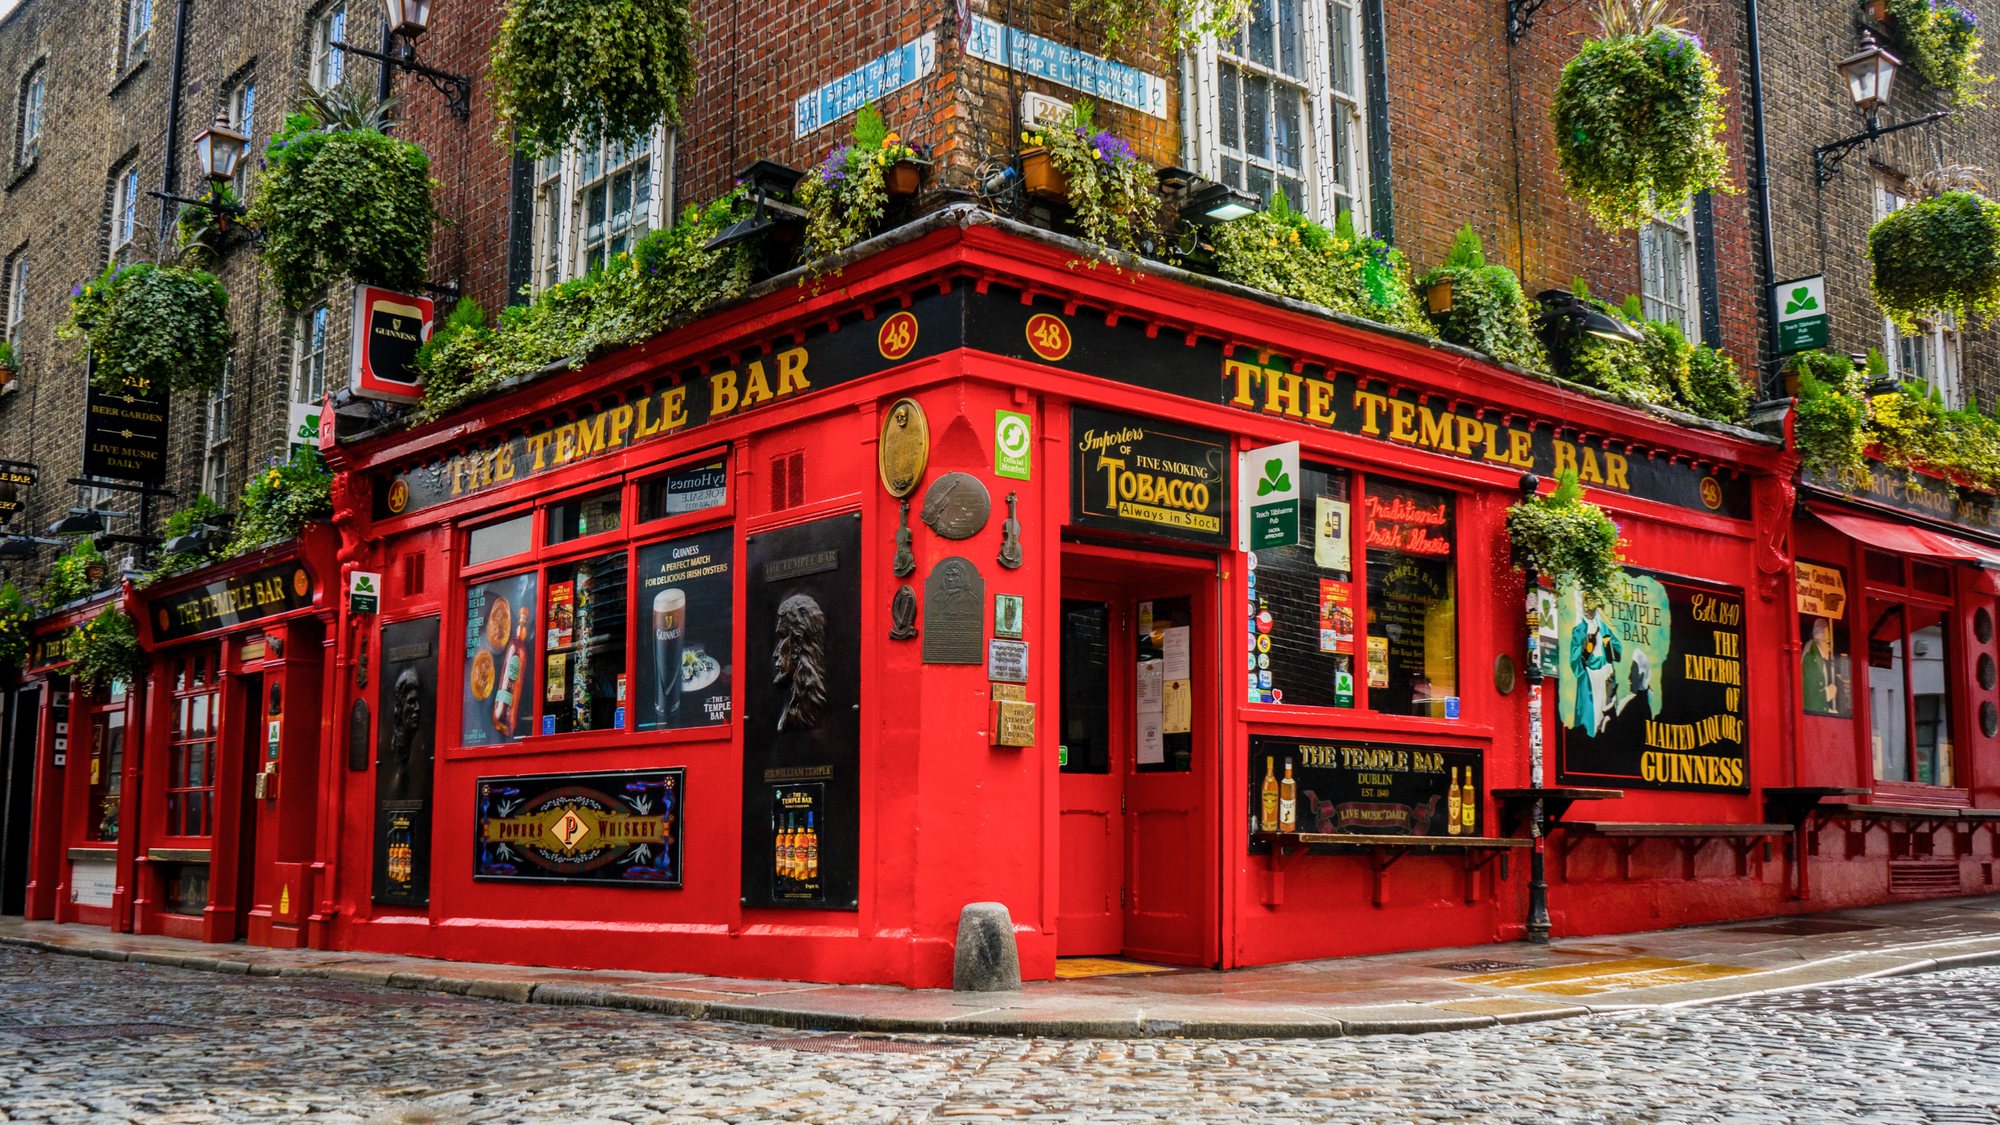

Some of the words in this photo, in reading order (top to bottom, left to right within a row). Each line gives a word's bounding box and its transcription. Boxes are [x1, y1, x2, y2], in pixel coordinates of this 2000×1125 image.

[1041, 44, 1056, 60] AN
[1062, 67, 1094, 90] LANE
[1098, 79, 1138, 105] SOUTH
[835, 84, 874, 114] TEMPLE
[375, 327, 417, 342] GUINNESS
[884, 320, 911, 352] 48
[1034, 319, 1062, 350] 48
[92, 404, 119, 417] BEER
[120, 409, 163, 423] GARDEN
[450, 442, 516, 495] THE
[528, 385, 690, 473] TEMPLE
[708, 346, 812, 420] BAR
[1222, 358, 1337, 428] THE
[1353, 389, 1536, 472] TEMPLE
[1552, 439, 1631, 493] BAR
[92, 443, 120, 455] LIVE
[121, 447, 159, 460] MUSIC
[1079, 427, 1145, 456] Importers
[1119, 445, 1132, 456] OF
[107, 457, 142, 470] DAILY
[1001, 462, 1026, 474] Member
[1136, 455, 1161, 471] FINE
[1161, 459, 1209, 480] SMOKING
[10, 473, 31, 484] BAR
[1096, 455, 1210, 513] TOBACCO
[392, 485, 405, 508] 48
[1702, 483, 1716, 503] 48
[1121, 502, 1164, 521] Always
[1169, 511, 1181, 524] in
[1184, 512, 1218, 530] Stock
[1269, 517, 1279, 525] Pub
[1365, 495, 1447, 526] Traditional
[672, 544, 700, 559] GUINNESS
[1406, 528, 1450, 555] Music
[661, 564, 666, 573] A
[666, 558, 690, 572] PERFECT
[690, 554, 711, 567] MATCH
[783, 553, 816, 571] TEMPLE
[645, 577, 657, 588] FOR
[656, 571, 686, 586] DELICIOUS
[686, 567, 702, 580] IRISH
[702, 563, 728, 576] OYSTERS
[1382, 565, 1420, 587] TEMPLE
[1812, 569, 1836, 587] Garden
[177, 600, 202, 626] THE
[202, 584, 254, 620] TEMPLE
[254, 576, 286, 606] BAR
[1803, 597, 1818, 613] Area
[1609, 600, 1662, 627] TEMPLE
[1719, 601, 1740, 627] 1840
[1622, 621, 1651, 646] BAR
[1713, 630, 1740, 658] THE
[1684, 653, 1741, 686] EMPEROR
[703, 701, 731, 713] TEMPLE
[1725, 686, 1741, 713] OF
[710, 711, 725, 721] BAR
[1645, 719, 1695, 751] MALTED
[1695, 714, 1744, 747] LIQUORS
[1299, 745, 1338, 769] THE
[1341, 747, 1410, 773] TEMPLE
[1412, 752, 1446, 775] BAR
[1641, 750, 1744, 787] GUINNESS
[1358, 773, 1393, 786] DUBLIN
[1361, 788, 1376, 798] EST.
[1376, 788, 1390, 799] 1840
[1341, 810, 1360, 821] LIVE
[1360, 810, 1385, 821] MUSIC
[1385, 810, 1409, 822] DAILY
[499, 821, 544, 839] POWERS
[564, 816, 577, 843] P
[598, 820, 657, 839] WHISKEY
